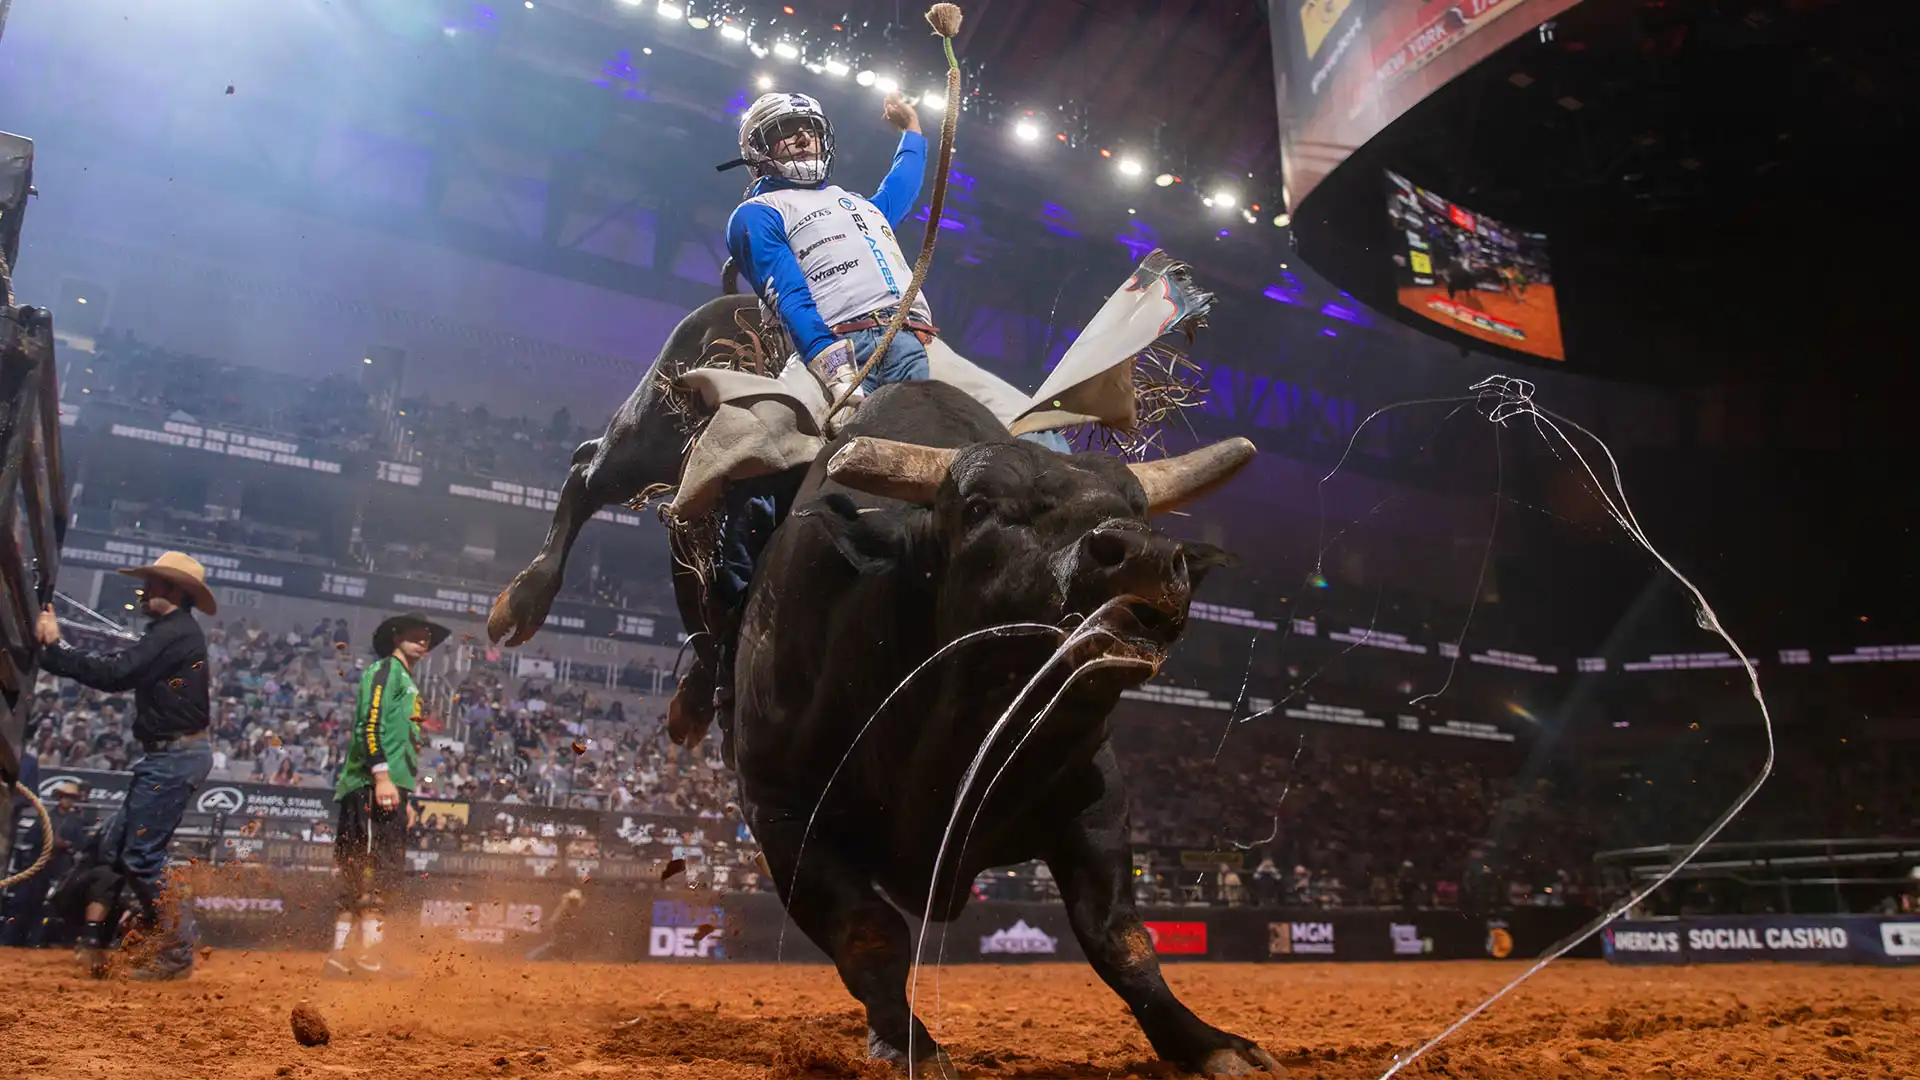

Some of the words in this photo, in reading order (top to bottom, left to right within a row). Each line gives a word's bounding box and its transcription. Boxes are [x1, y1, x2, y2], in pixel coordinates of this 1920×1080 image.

[1408, 21, 1450, 55] YORK
[810, 258, 860, 282] Wrangler
[227, 590, 257, 608] 105
[589, 638, 615, 653] 106
[246, 794, 285, 807] RAMPS,
[287, 796, 325, 810] STAIRS,
[269, 806, 329, 819] PLATFORMS
[195, 896, 284, 913] MONSTER
[1291, 922, 1334, 942] MGM
[1688, 929, 1763, 950] SOCIAL
[1765, 927, 1848, 949] CASINO
[649, 927, 724, 957] DEF
